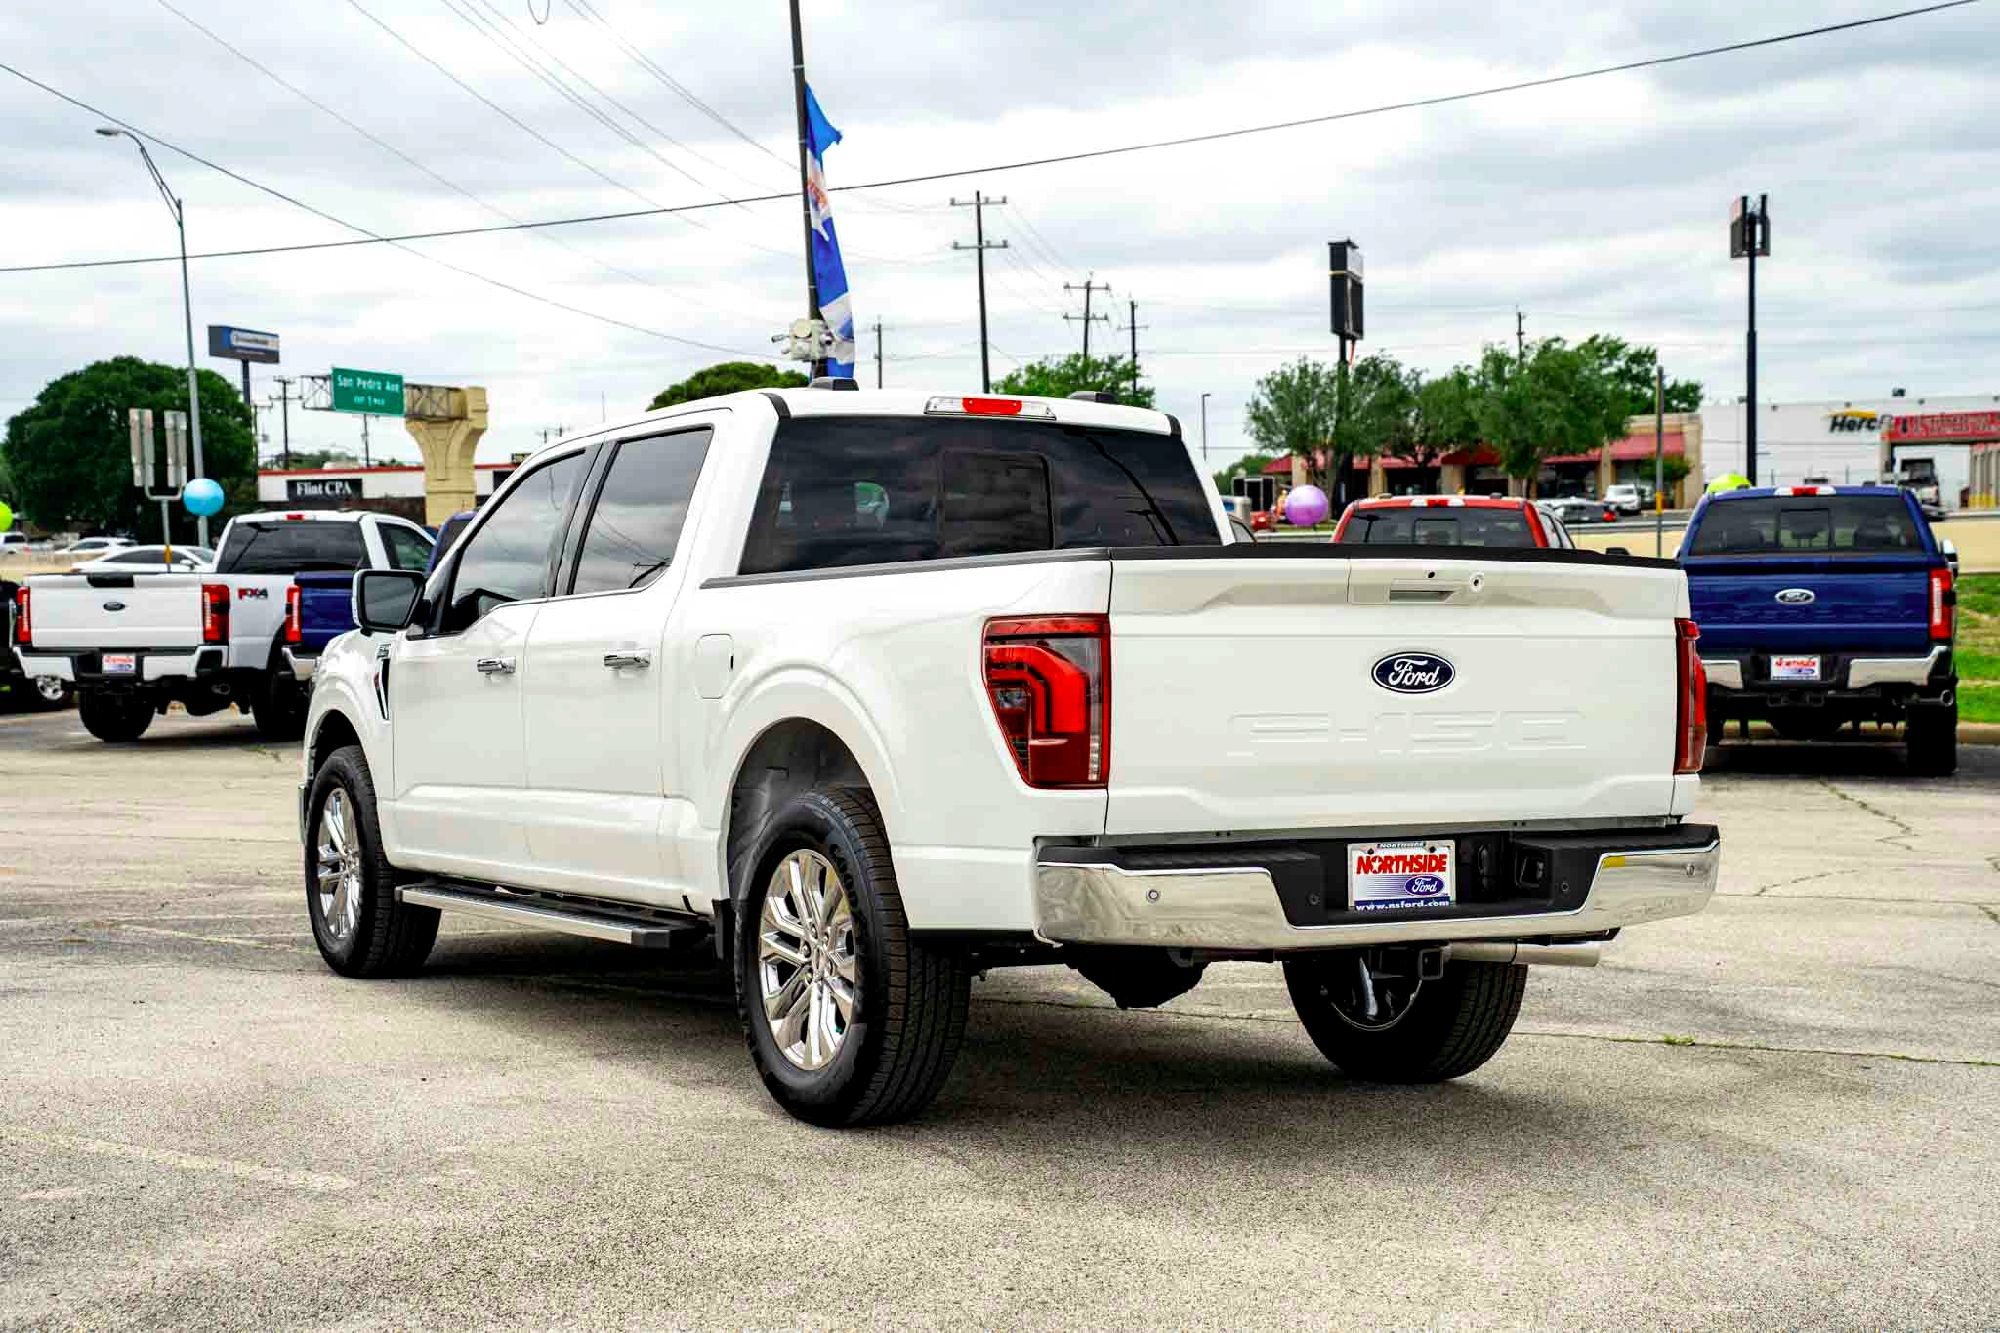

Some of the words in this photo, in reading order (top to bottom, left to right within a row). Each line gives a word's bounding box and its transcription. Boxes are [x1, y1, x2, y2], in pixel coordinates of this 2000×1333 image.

[337, 374, 353, 388] San
[356, 376, 382, 391] Pedro
[385, 380, 399, 393] Ave
[297, 481, 323, 496] Flint
[324, 480, 352, 497] CPA
[238, 588, 268, 600] FX4
[1388, 658, 1440, 686] Ford
[1356, 854, 1448, 875] NORTHSIDE
[1412, 877, 1438, 893] Ford
[1355, 899, 1449, 911] www.nsford.com
